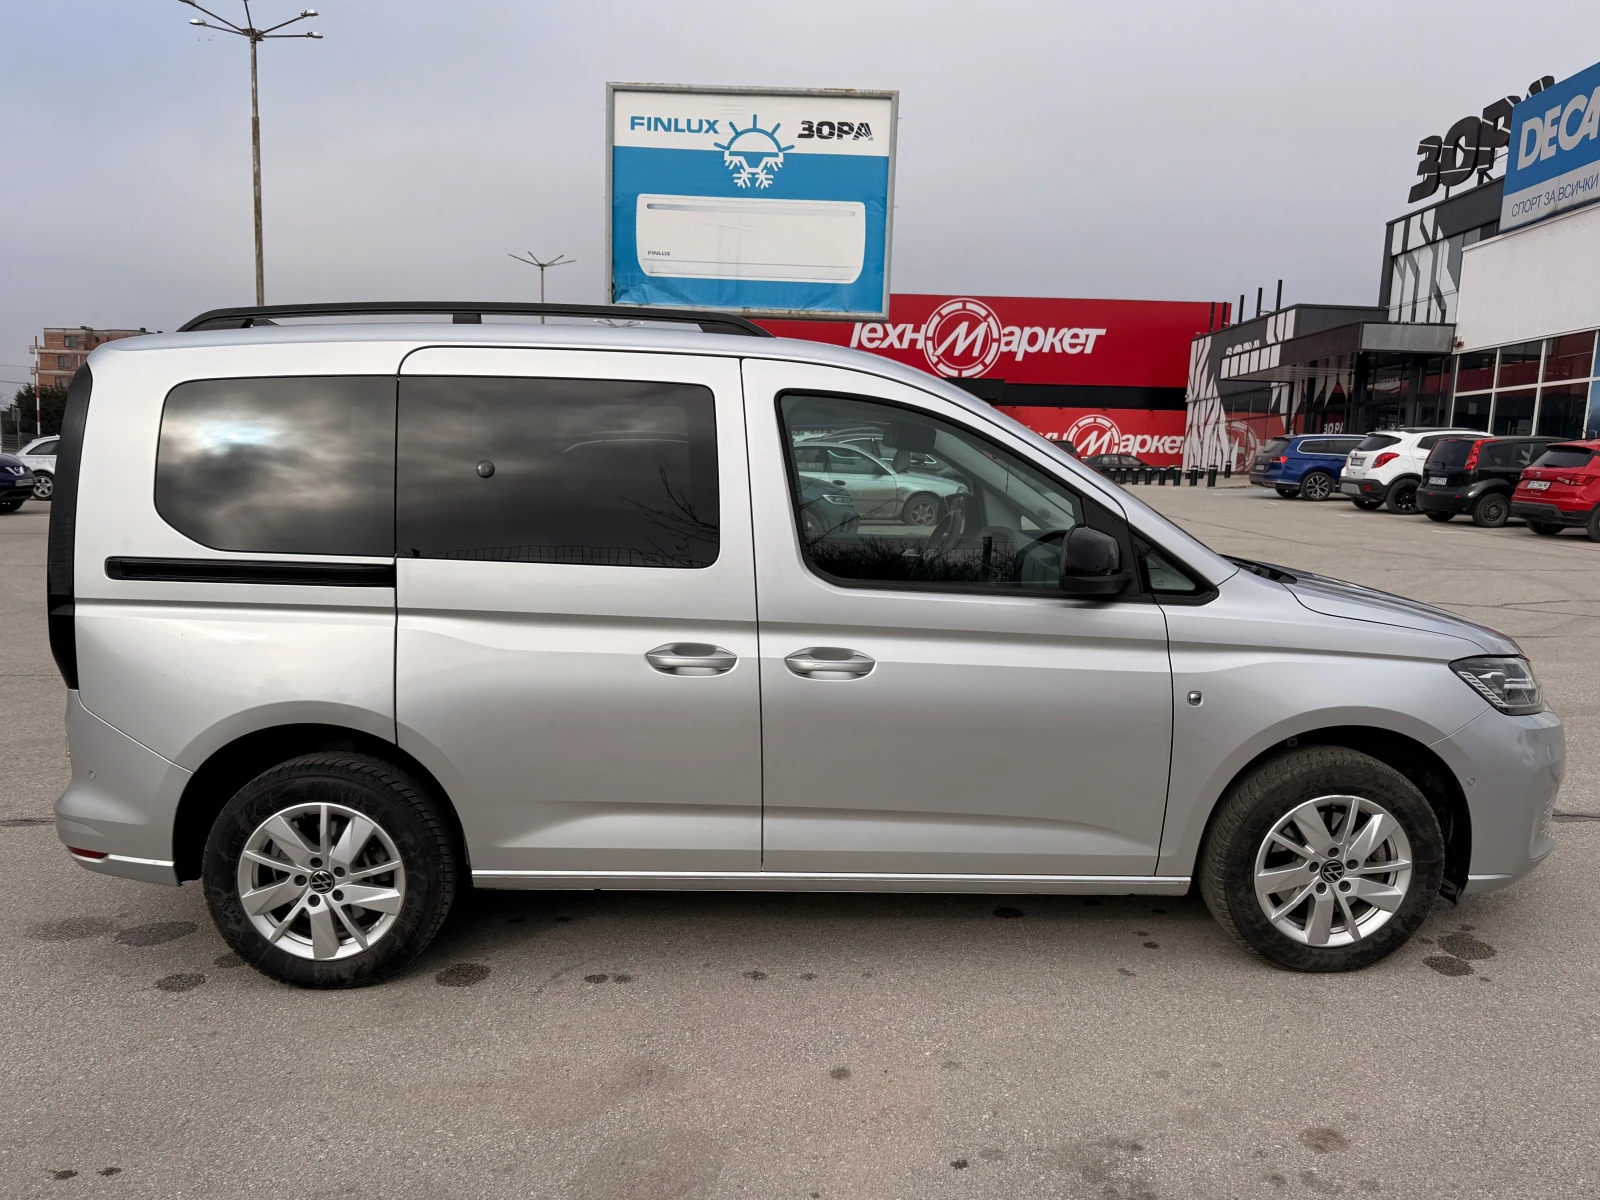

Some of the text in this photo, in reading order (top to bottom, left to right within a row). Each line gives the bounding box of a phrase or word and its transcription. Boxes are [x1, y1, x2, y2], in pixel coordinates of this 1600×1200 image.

[630, 115, 720, 134] FINLUX
[797, 120, 874, 141] ЗОРА
[1516, 86, 1600, 171] DECA
[1511, 172, 1600, 217] СПОРТ ЗА ВСИЧКИ
